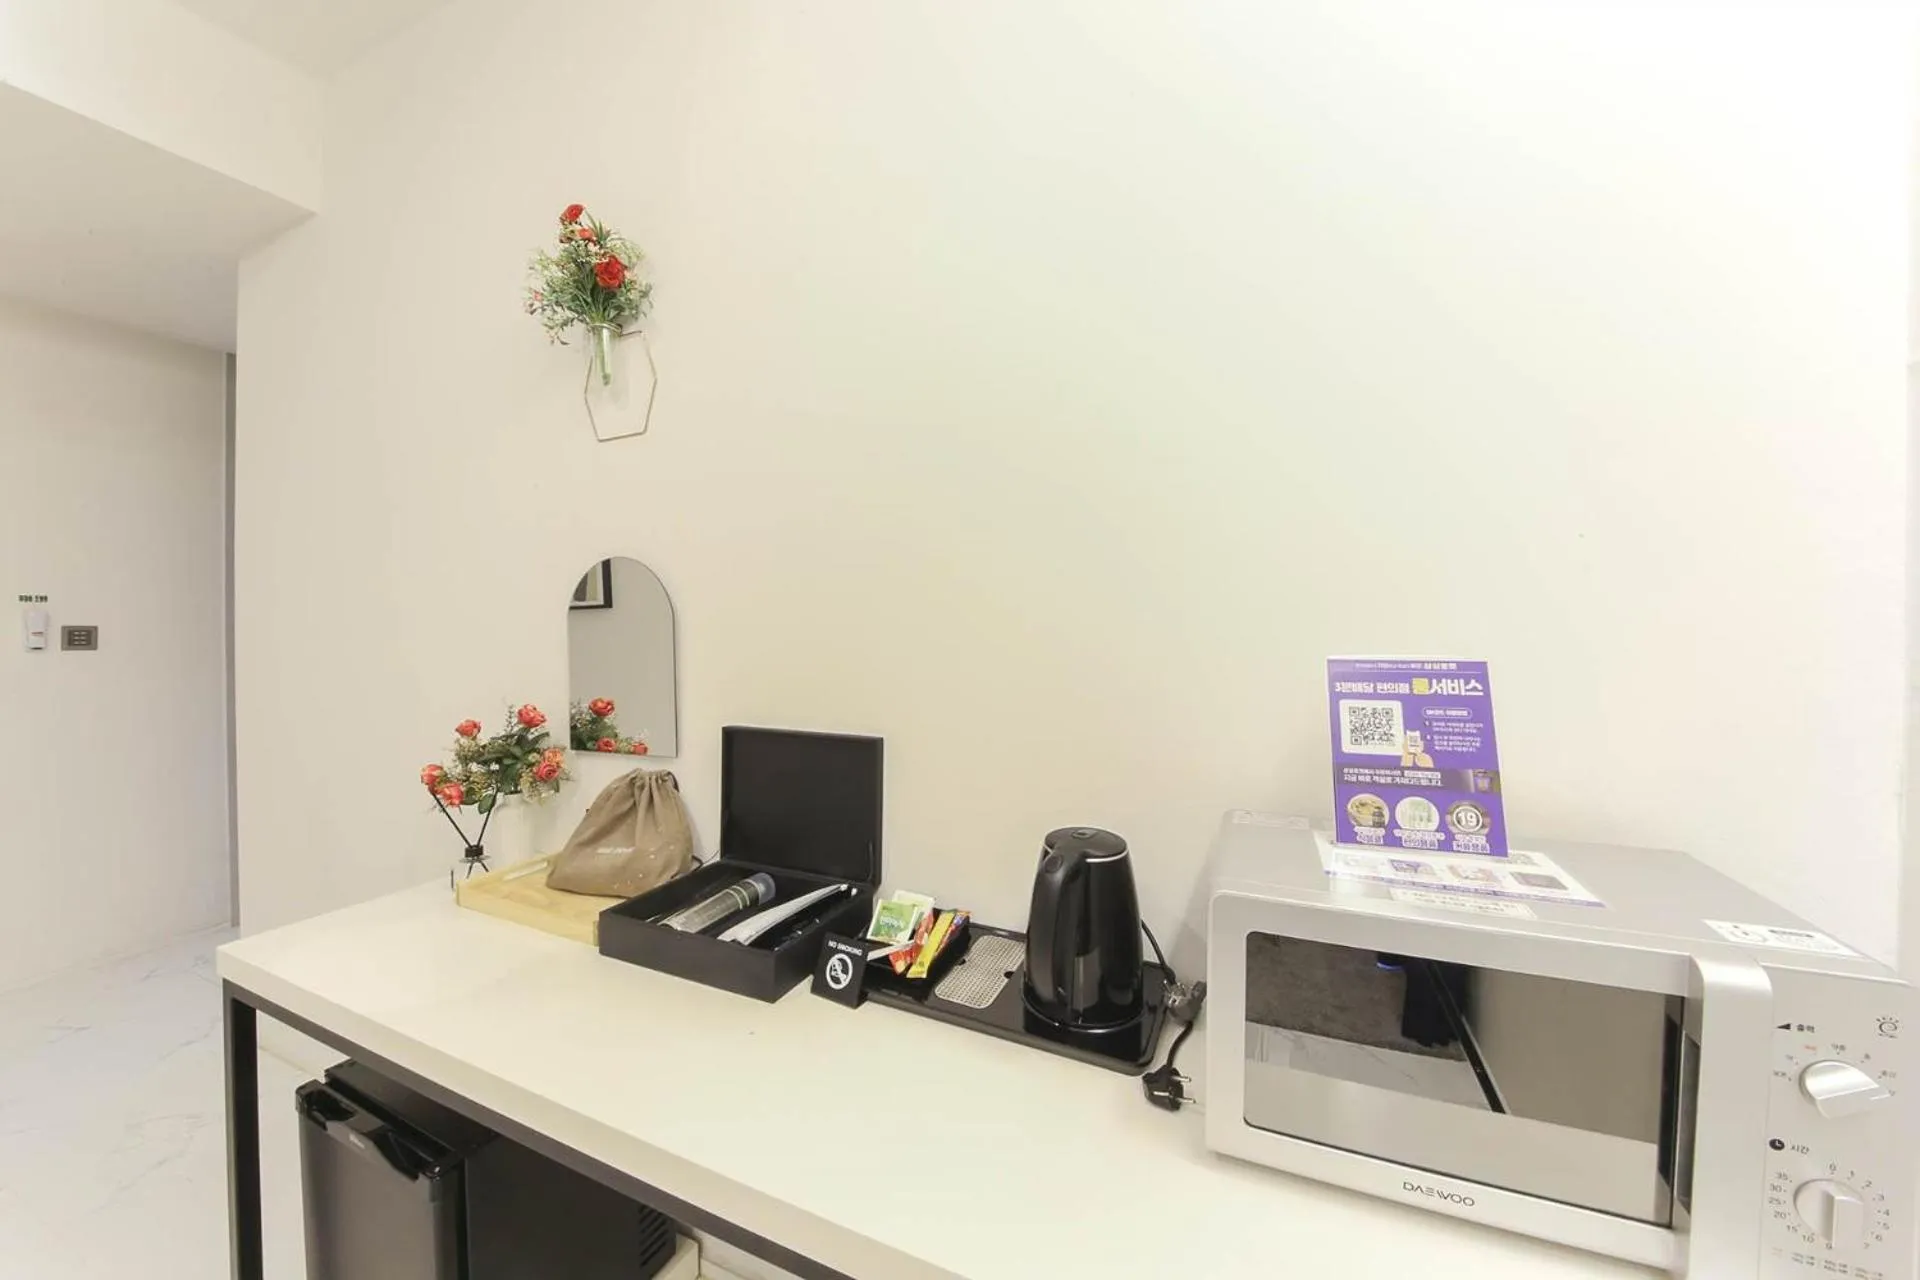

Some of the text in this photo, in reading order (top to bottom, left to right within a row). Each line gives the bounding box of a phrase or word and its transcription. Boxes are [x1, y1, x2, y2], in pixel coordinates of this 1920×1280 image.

[1458, 811, 1477, 826] 19
[828, 940, 862, 957] NO SMOKING
[1402, 1181, 1476, 1207] DAEWOO
[1802, 1234, 1815, 1243] 10
